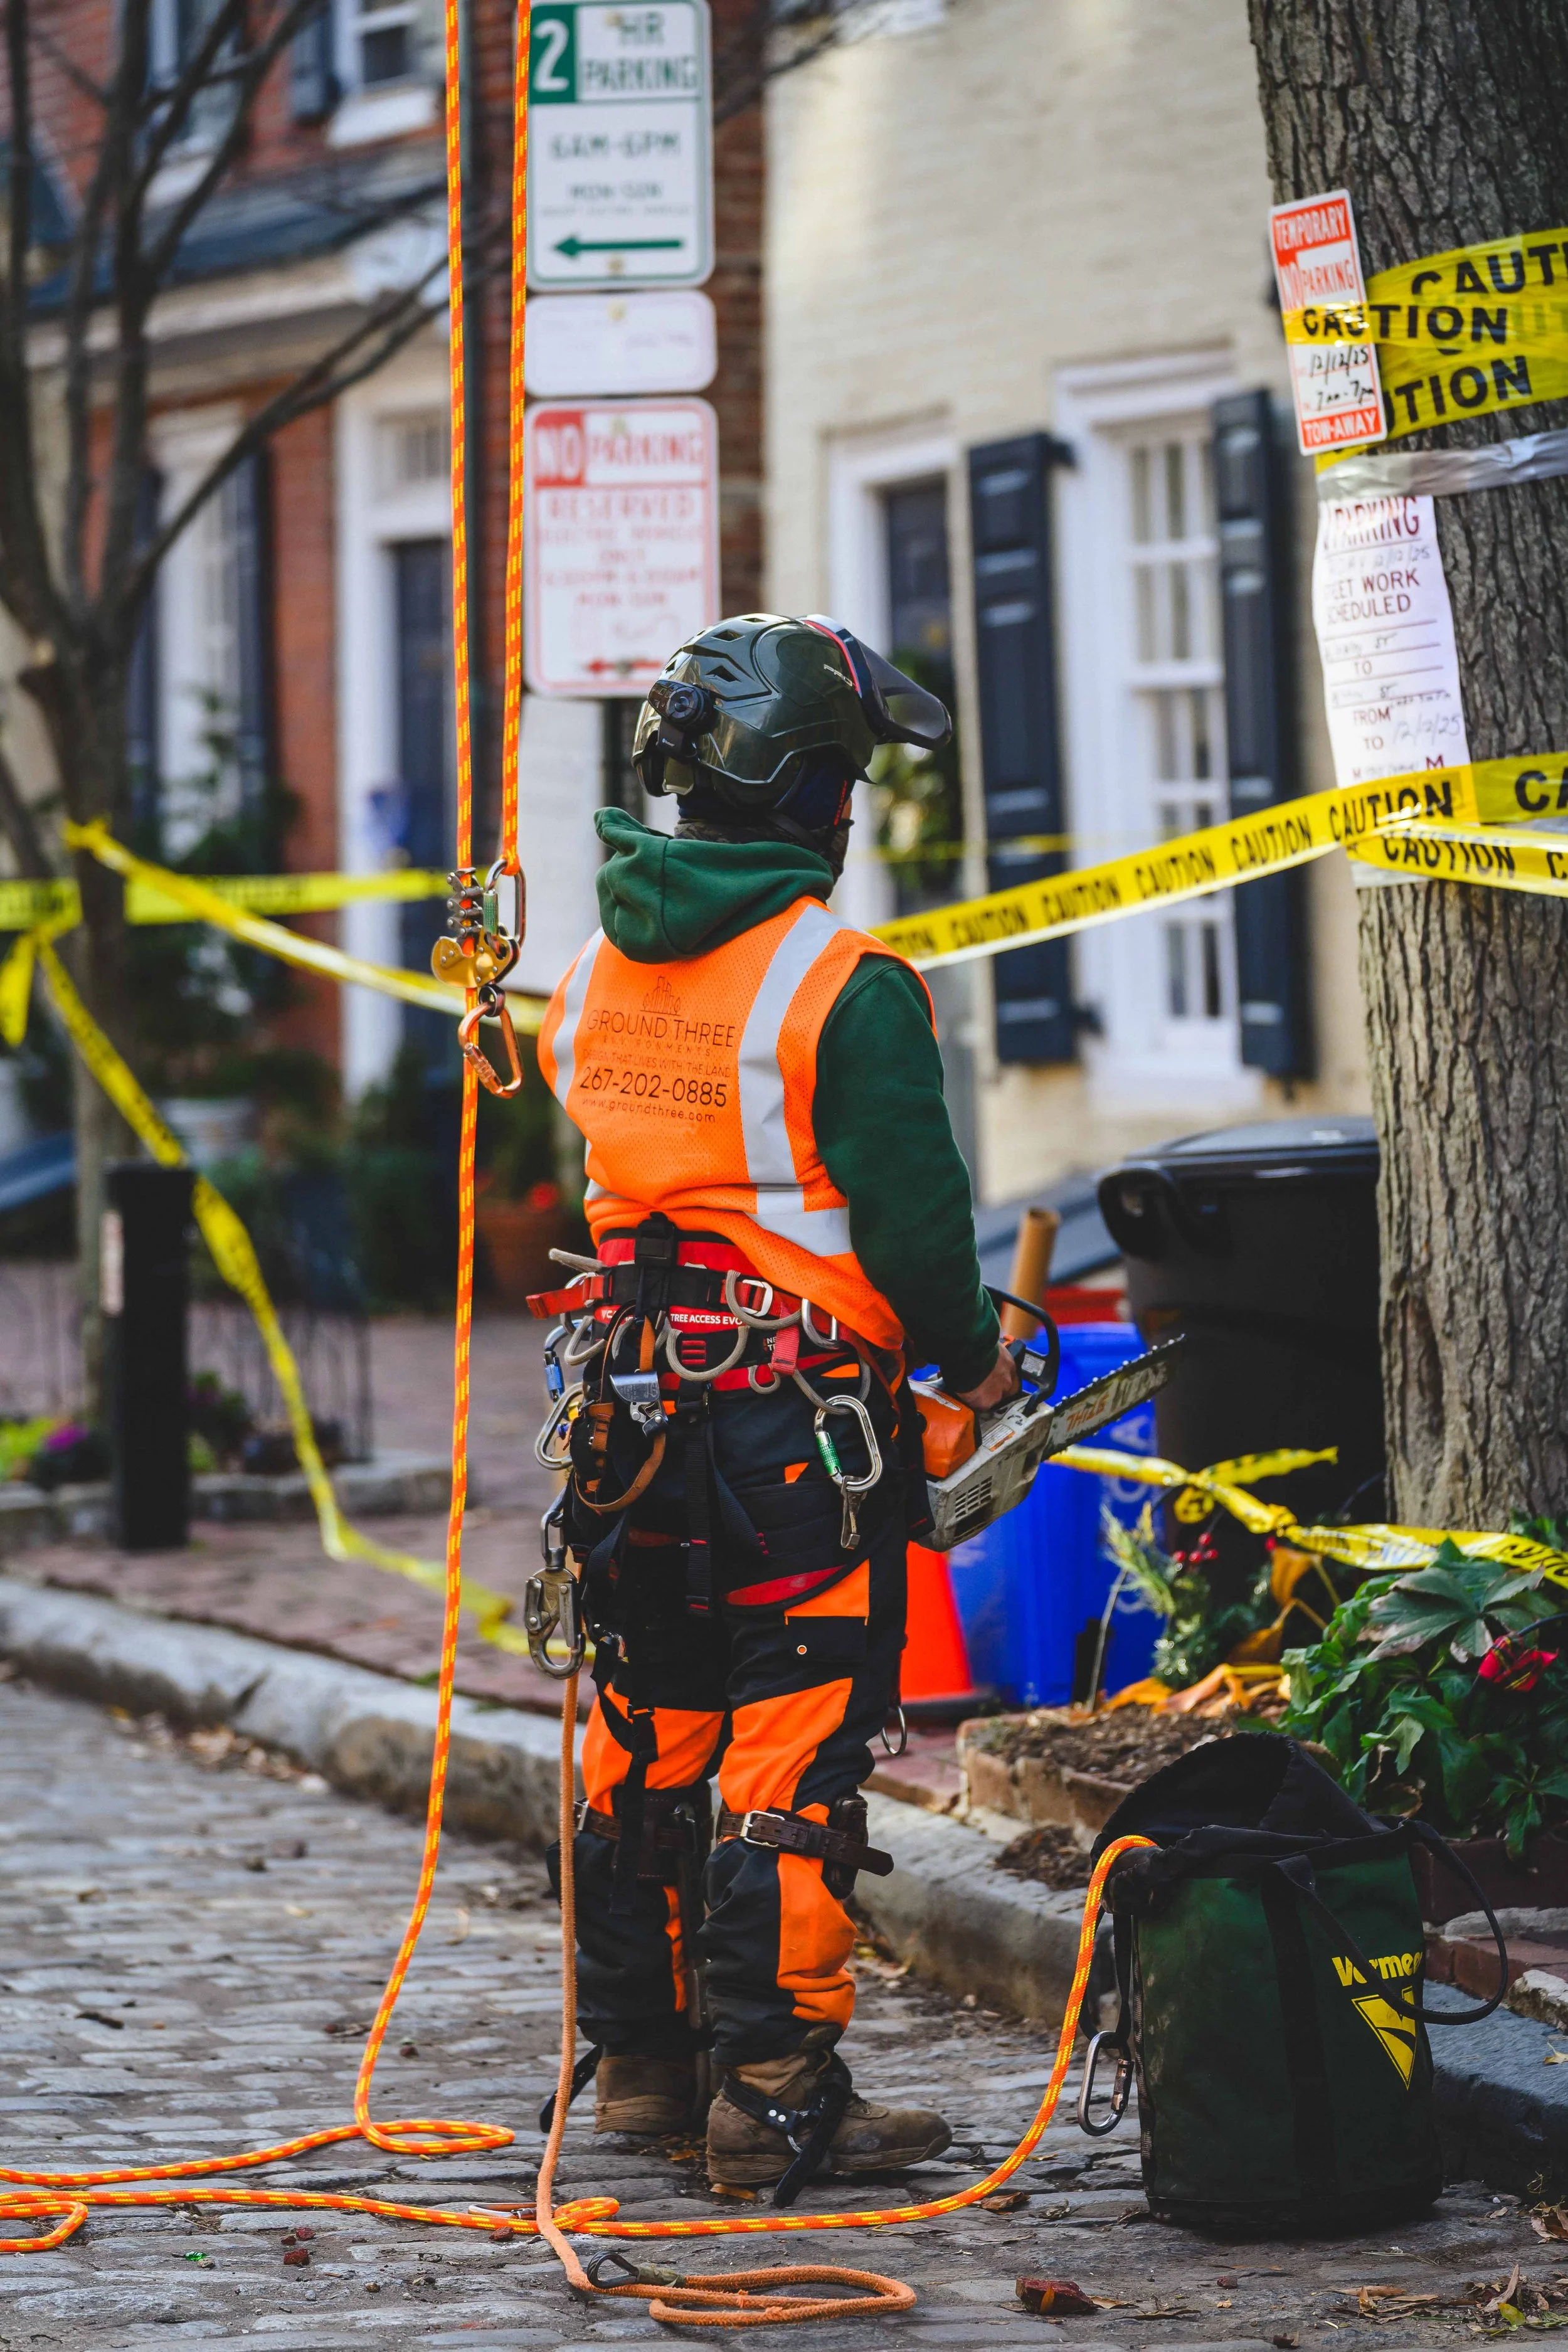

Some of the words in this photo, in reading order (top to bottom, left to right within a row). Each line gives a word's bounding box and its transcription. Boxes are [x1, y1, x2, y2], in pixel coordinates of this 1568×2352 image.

[619, 12, 665, 46] HR
[533, 19, 569, 92] 2
[585, 57, 698, 91] PARKING
[1274, 203, 1347, 251] TEMPORARY
[1302, 258, 1354, 299] PARKING
[1303, 304, 1508, 344] CAUTION
[1305, 410, 1377, 447] TOW-AWAY
[534, 424, 581, 479] NO
[590, 434, 704, 465] PARKING
[1362, 568, 1421, 594] WORK
[1353, 660, 1372, 675] TO
[1353, 706, 1391, 726] FROM
[1364, 736, 1384, 751] TO
[1042, 874, 1122, 926] CAUTION
[1135, 844, 1216, 900] CAUTION
[1230, 813, 1312, 871] CAUTION
[1328, 781, 1454, 841] CAUTION
[1382, 829, 1516, 879] CAUTION
[586, 1009, 667, 1039] GROUND
[674, 1019, 736, 1047] THREE
[580, 1066, 727, 1108] 267-202-0885
[582, 1098, 716, 1123] www.groundthree.com
[670, 1313, 689, 1323] TREE
[689, 1315, 721, 1325] ACCESS
[723, 1316, 743, 1325] EVO
